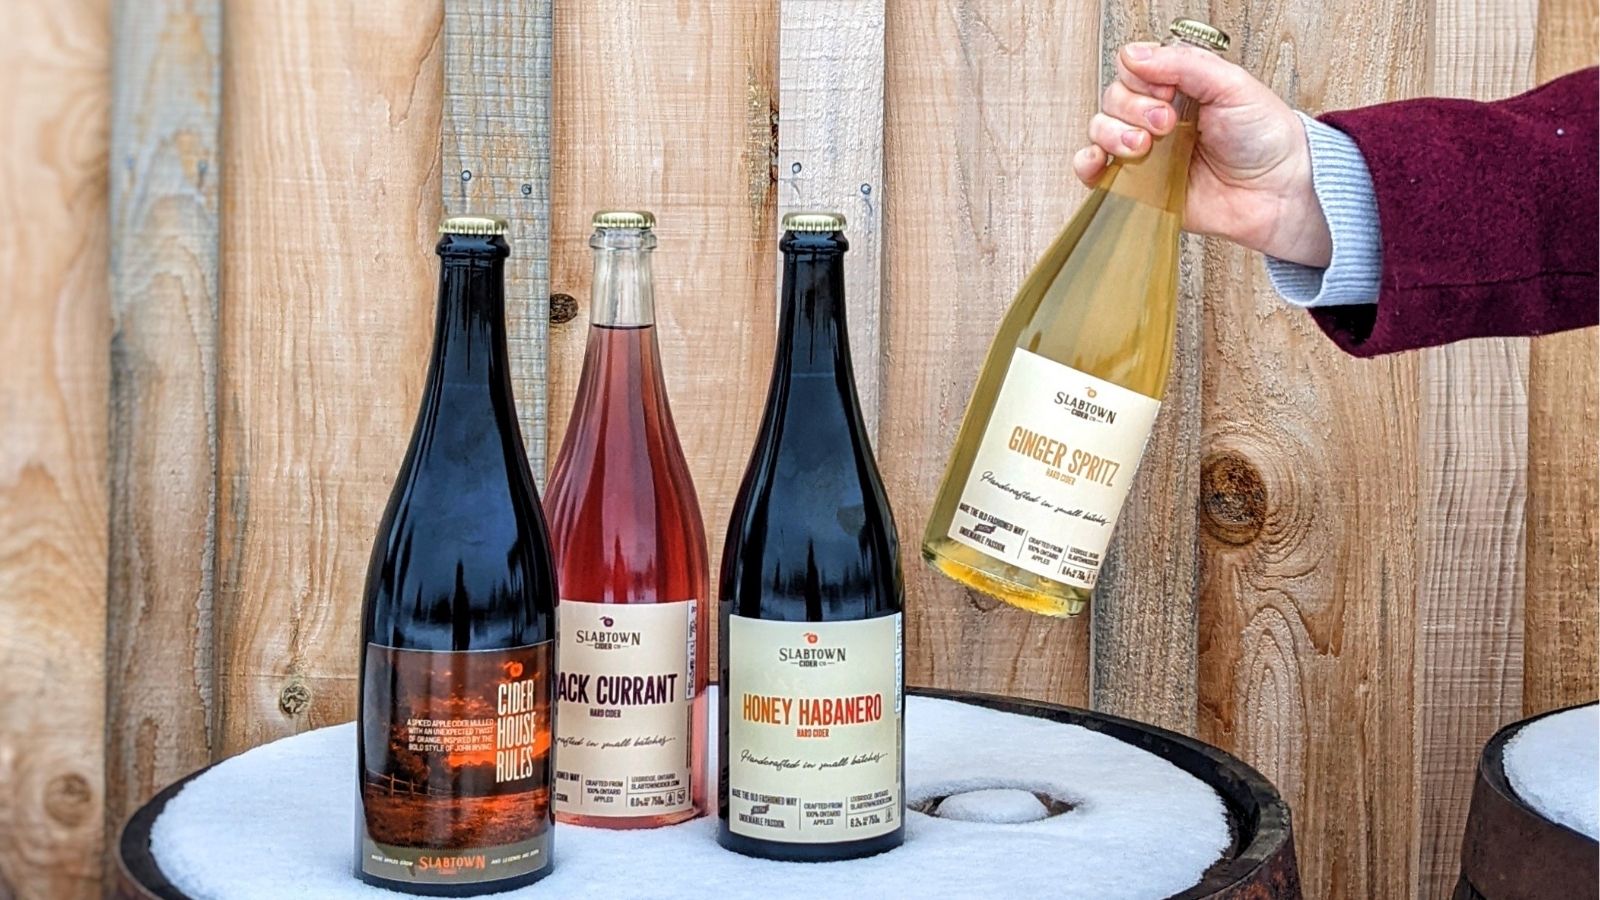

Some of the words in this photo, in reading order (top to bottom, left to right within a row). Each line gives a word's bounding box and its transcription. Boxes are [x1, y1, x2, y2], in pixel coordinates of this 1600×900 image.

[1054, 391, 1118, 424] SLABTOWN
[1071, 408, 1088, 420] CIDER
[1008, 425, 1068, 469] GINGER
[1068, 448, 1120, 488] SPRITZ
[1045, 468, 1060, 480] HARD
[980, 470, 1039, 503] Handcrafted
[1040, 499, 1052, 508] in
[1054, 506, 1082, 518] small
[970, 506, 980, 518] THE
[978, 510, 988, 522] OLD
[987, 514, 1014, 532] FASHIONED
[1013, 526, 1026, 536] WAY
[1028, 536, 1051, 550] CRAFTED
[1050, 544, 1064, 554] FROM
[1028, 544, 1040, 554] 100%
[1031, 554, 1050, 566] APPLES
[576, 630, 641, 646] SLABTOWN
[779, 648, 846, 662] SLABTOWN
[558, 672, 590, 704] ACK
[596, 674, 678, 706] CURRANT
[498, 679, 534, 716] CIDER
[590, 708, 604, 718] HARD
[605, 708, 622, 718] CIDER
[743, 693, 793, 726] HONEY
[798, 693, 882, 726] HABANERO
[406, 718, 412, 726] A
[412, 718, 432, 726] SPICED
[432, 720, 452, 728] APPLE
[470, 718, 494, 727] MULLED
[434, 728, 474, 736] UNEXPECTED
[474, 726, 494, 734] TWIST
[496, 712, 536, 750] HOUSE
[796, 728, 812, 738] HARD
[812, 728, 830, 738] CIDER
[443, 736, 471, 744] INSPIRED
[472, 735, 480, 744] BY
[482, 734, 494, 742] THE
[556, 736, 584, 748] rafted
[586, 740, 599, 748] in
[601, 738, 632, 750] small
[408, 743, 424, 751] BOLD
[424, 744, 444, 752] STYLE
[445, 744, 454, 752] OF
[454, 744, 472, 752] JOHN
[496, 746, 534, 783] RULES
[740, 749, 801, 772] Handcrafted
[802, 761, 816, 769] in
[818, 757, 849, 770] small
[570, 772, 580, 782] WAY
[585, 780, 608, 788] CRAFTED
[594, 795, 614, 803] APPLES
[742, 790, 750, 800] THE
[750, 792, 758, 802] OLD
[759, 794, 784, 806] FASHIONED
[786, 797, 798, 806] WAY
[418, 854, 486, 870] SLABTOWN
